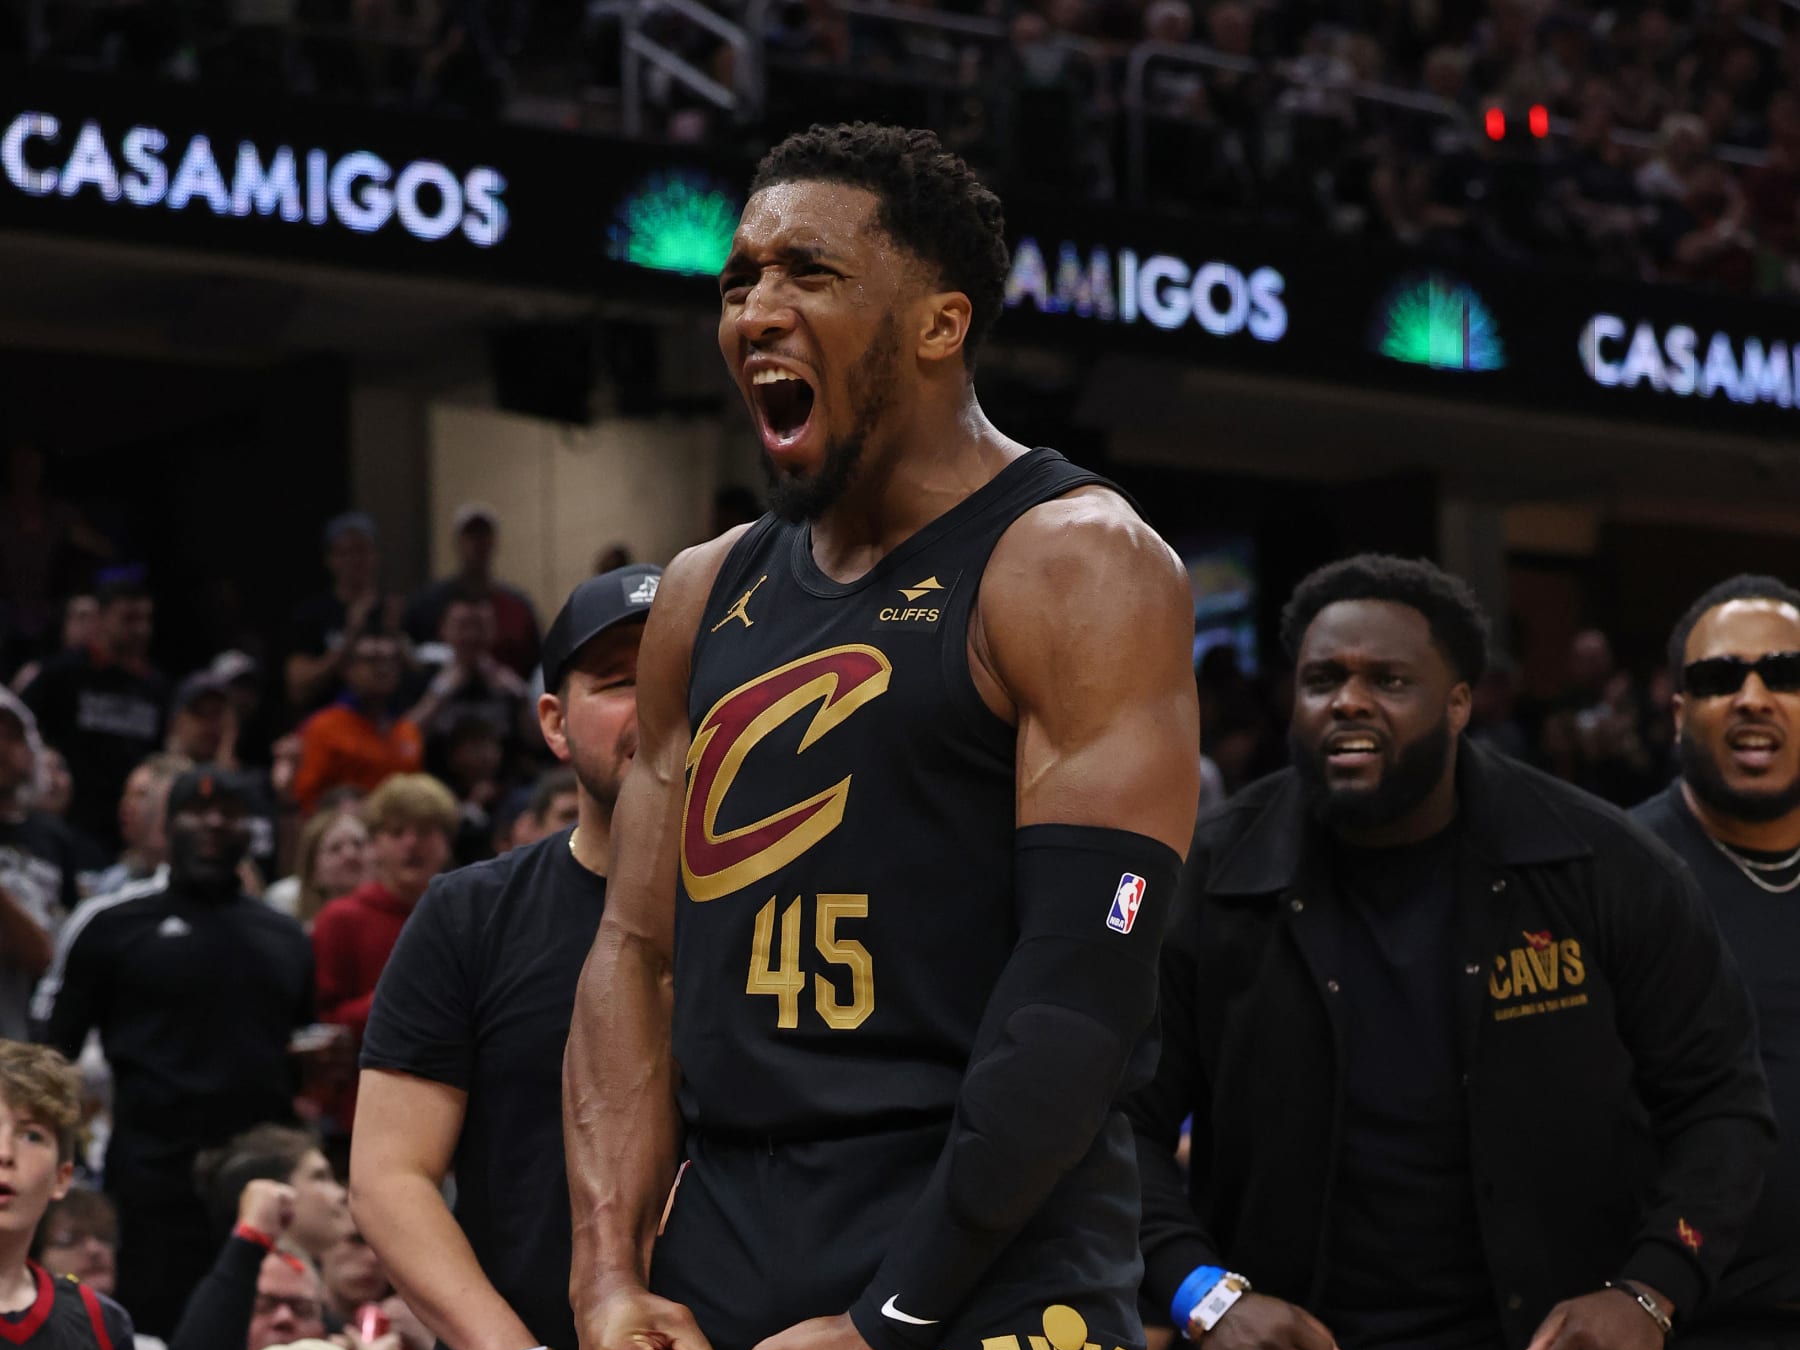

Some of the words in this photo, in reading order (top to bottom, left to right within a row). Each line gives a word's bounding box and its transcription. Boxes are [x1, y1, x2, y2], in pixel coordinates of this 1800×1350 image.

[1, 110, 508, 248] CASAMIGOS
[1003, 236, 1288, 343] AMIGOS
[880, 607, 940, 622] CLIFFS
[680, 643, 893, 903] C
[746, 893, 875, 1030] 45
[1110, 916, 1125, 929] NBA
[1489, 938, 1586, 1000] CAVS
